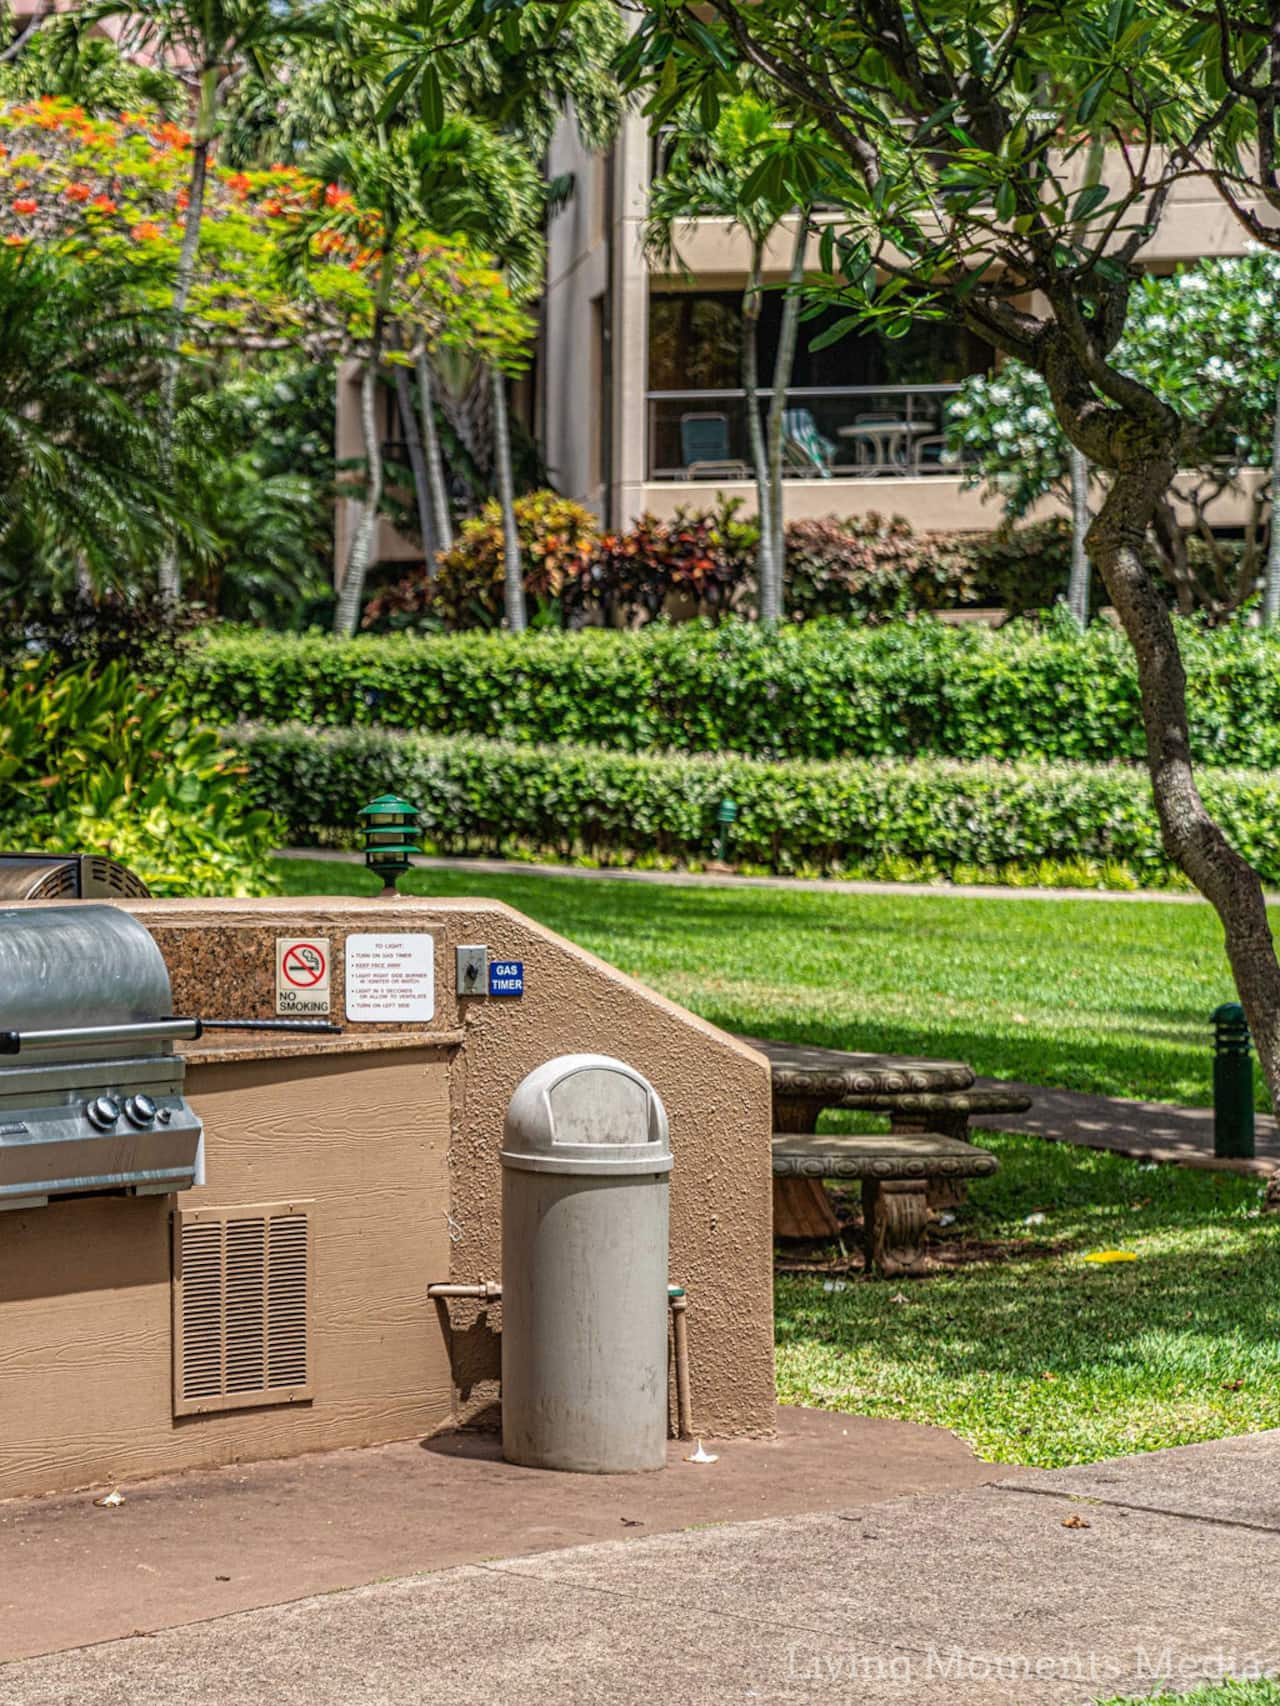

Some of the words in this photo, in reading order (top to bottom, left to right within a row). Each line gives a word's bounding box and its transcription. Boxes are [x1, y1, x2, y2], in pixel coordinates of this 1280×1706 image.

[496, 965, 518, 976] GAS
[492, 979, 522, 990] TIMER
[280, 992, 296, 1001] NO
[280, 1001, 328, 1011] SMOKING
